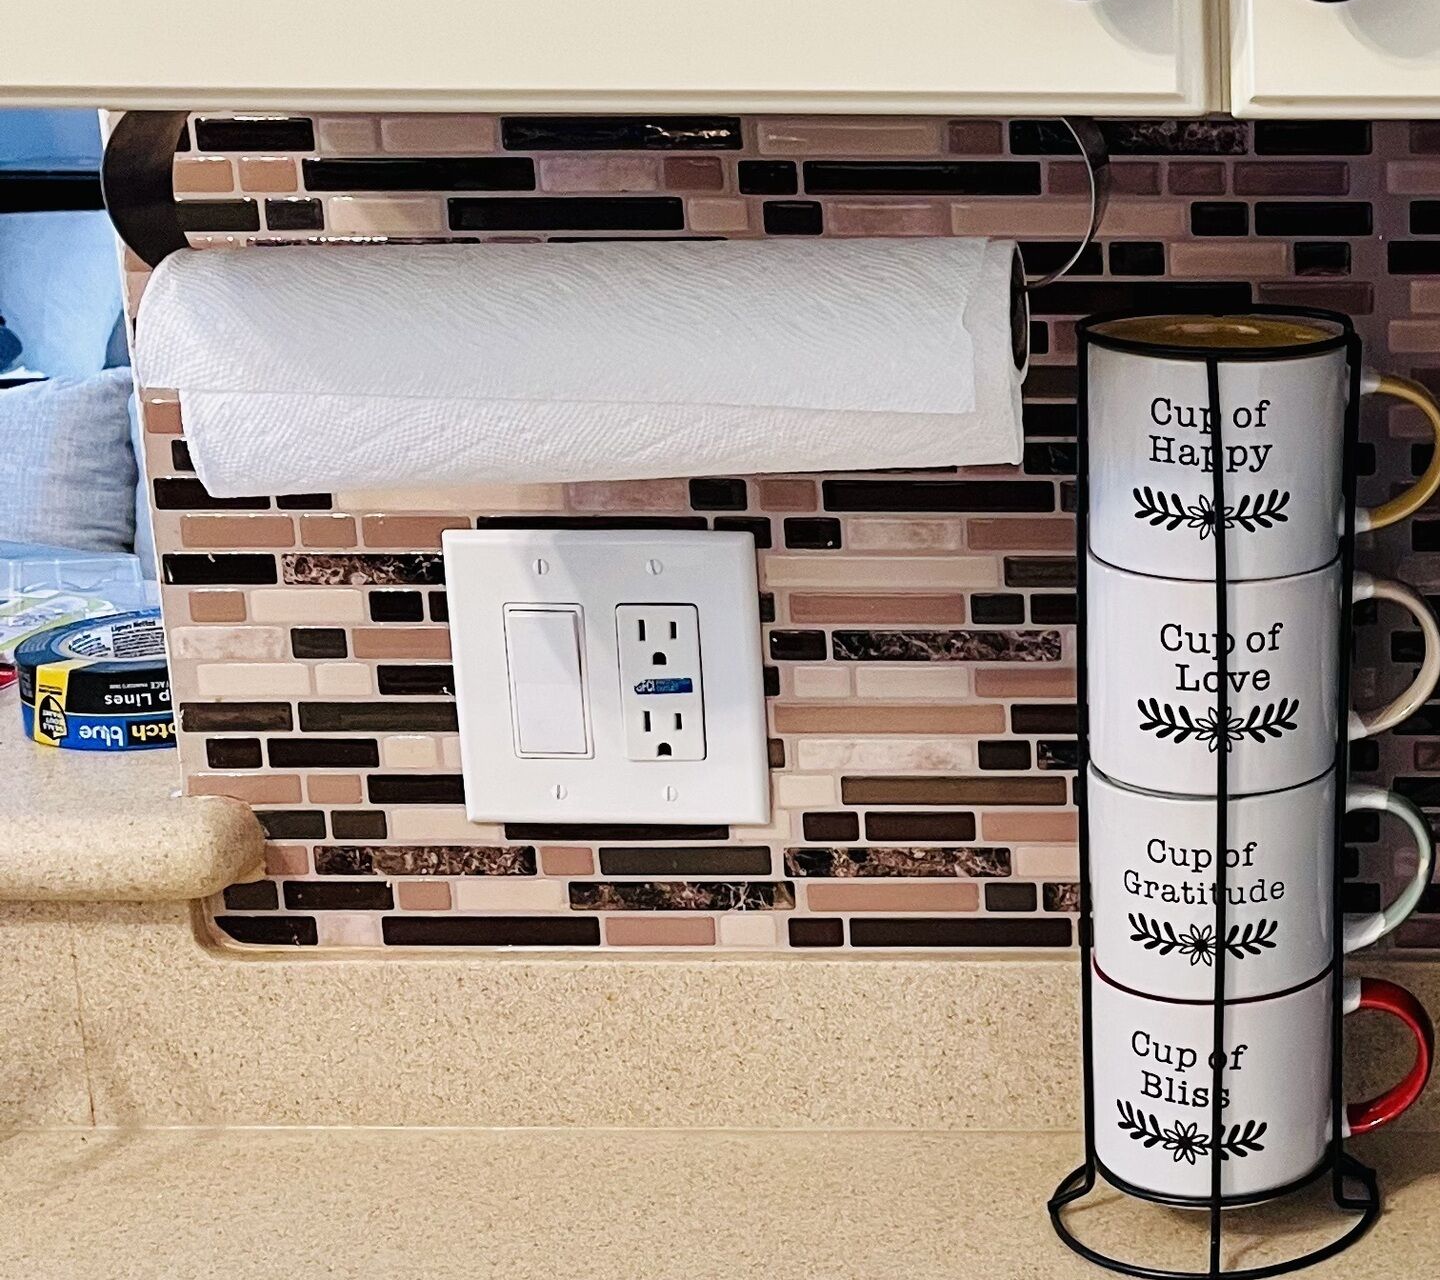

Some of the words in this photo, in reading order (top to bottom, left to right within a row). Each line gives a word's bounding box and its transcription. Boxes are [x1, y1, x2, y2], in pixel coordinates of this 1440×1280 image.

[1151, 397, 1214, 434] Cup
[1232, 399, 1271, 429] of
[1148, 434, 1273, 473] Happy
[1160, 623, 1236, 661] Cup
[1246, 622, 1284, 653] of
[1174, 663, 1271, 693] Love
[104, 693, 152, 707] Lines
[79, 725, 124, 747] blue
[131, 722, 176, 741] otch
[1147, 838, 1213, 873] Cup
[1223, 841, 1258, 868] of
[1123, 869, 1285, 905] Gratitude
[1131, 1030, 1197, 1073] Cup
[1208, 1044, 1249, 1070] of
[1140, 1069, 1231, 1109] Bliss
